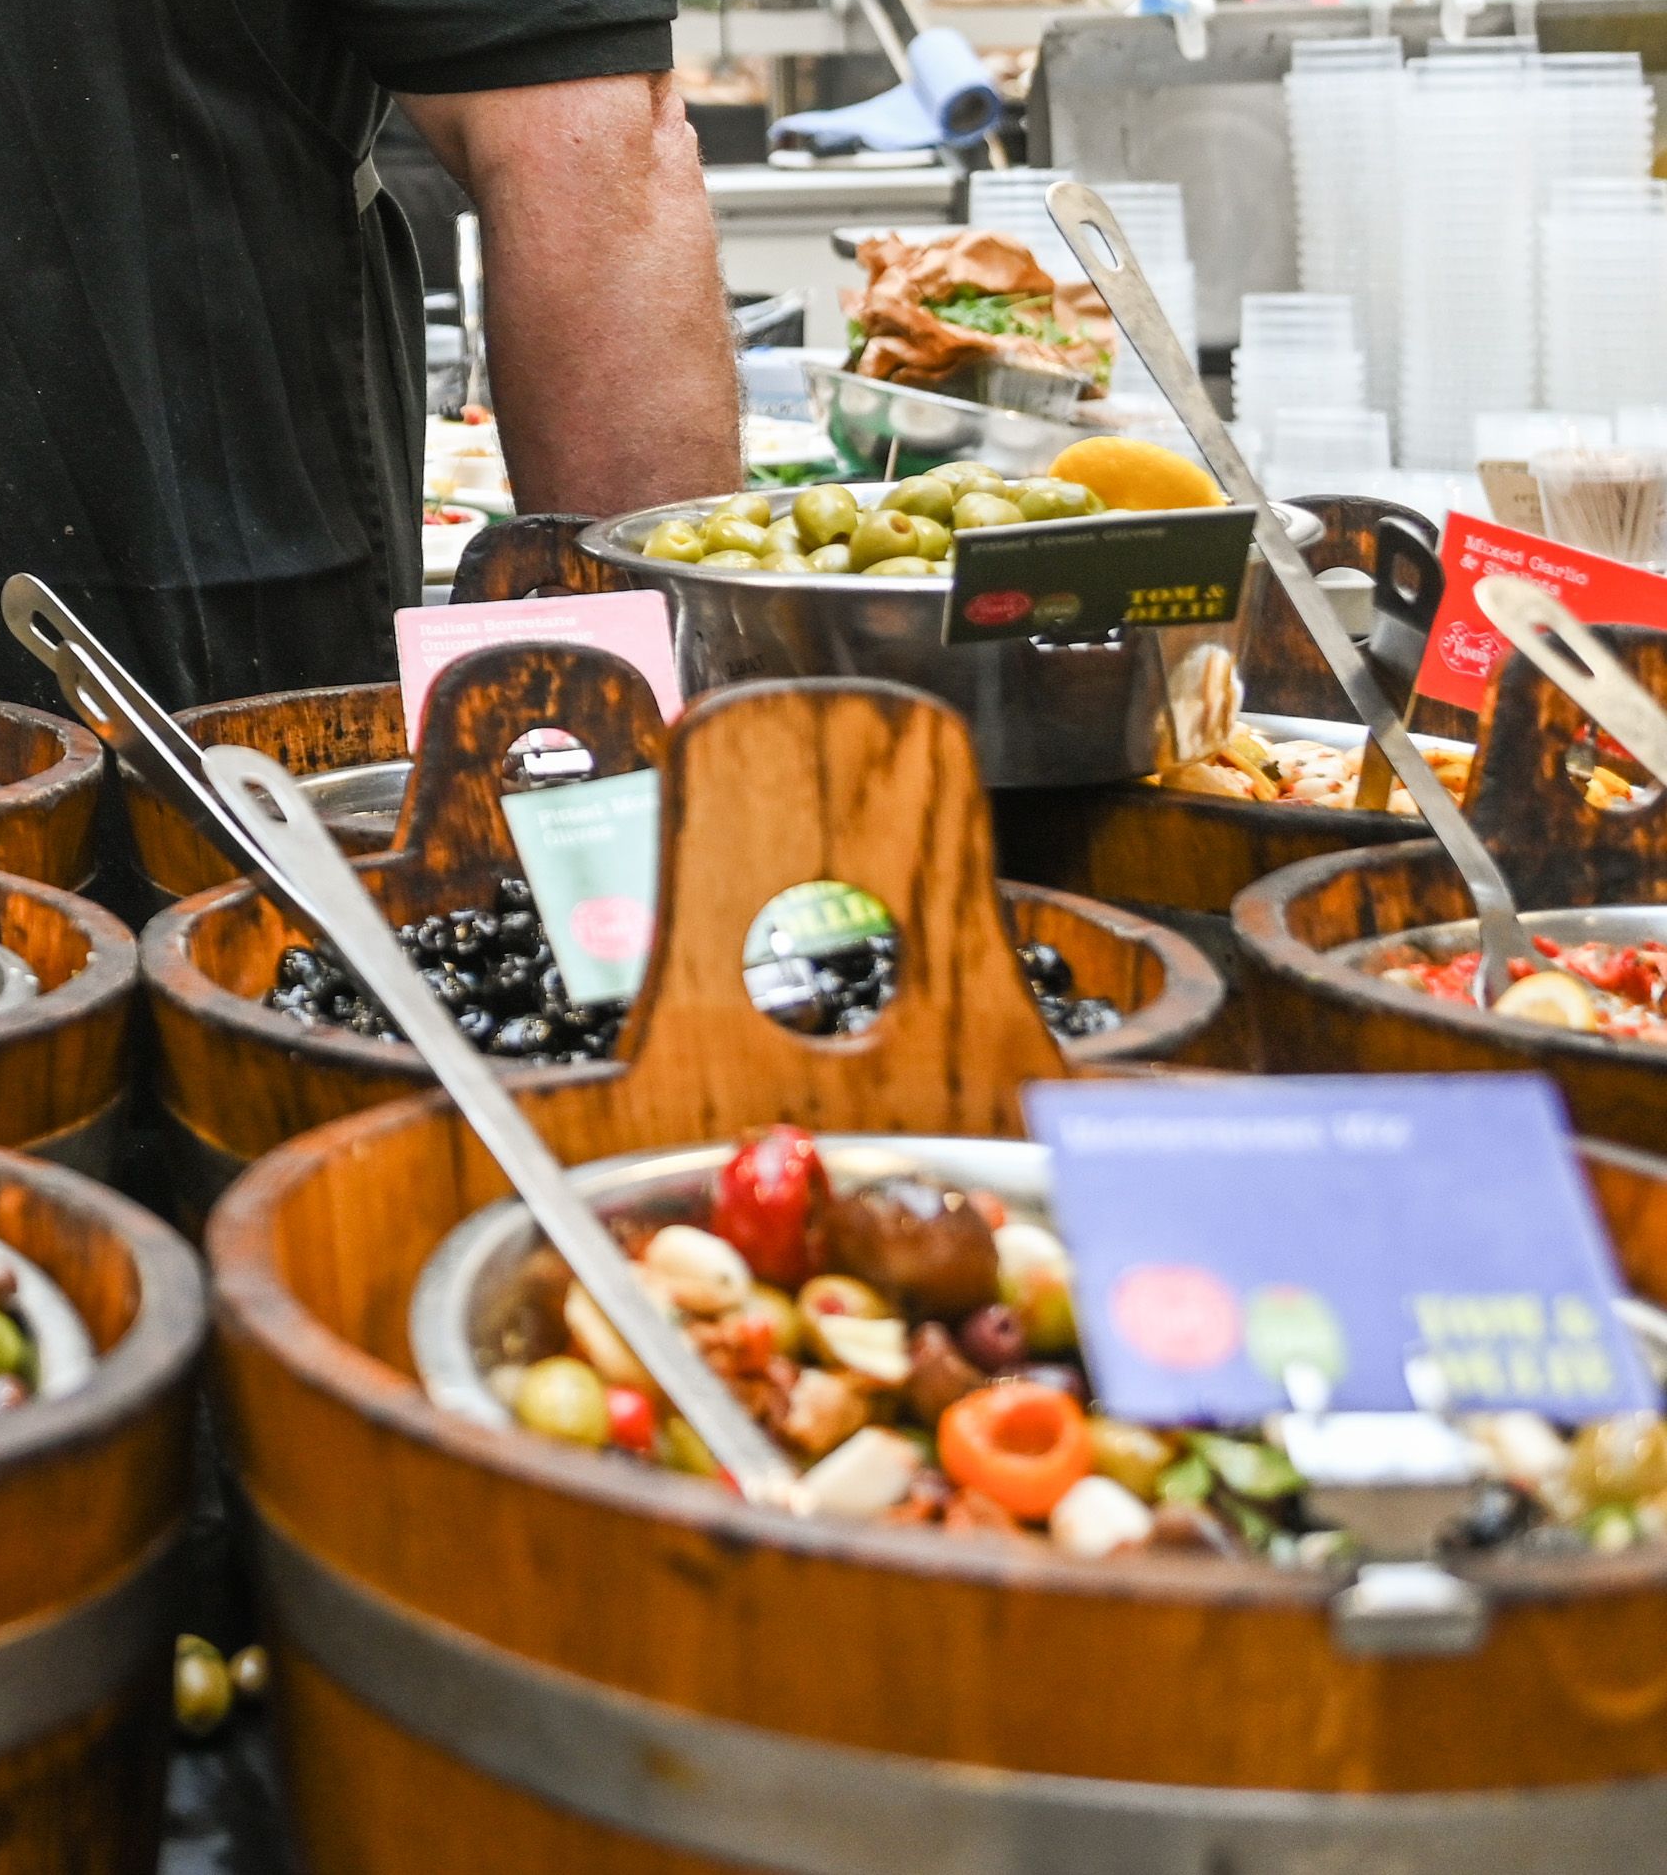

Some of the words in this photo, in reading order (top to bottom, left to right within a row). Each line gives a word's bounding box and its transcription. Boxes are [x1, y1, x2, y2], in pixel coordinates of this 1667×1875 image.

[1464, 534, 1525, 566] Mixed
[1527, 556, 1589, 586] Garlic
[419, 621, 478, 637] Italian
[1451, 639, 1491, 666] Tom
